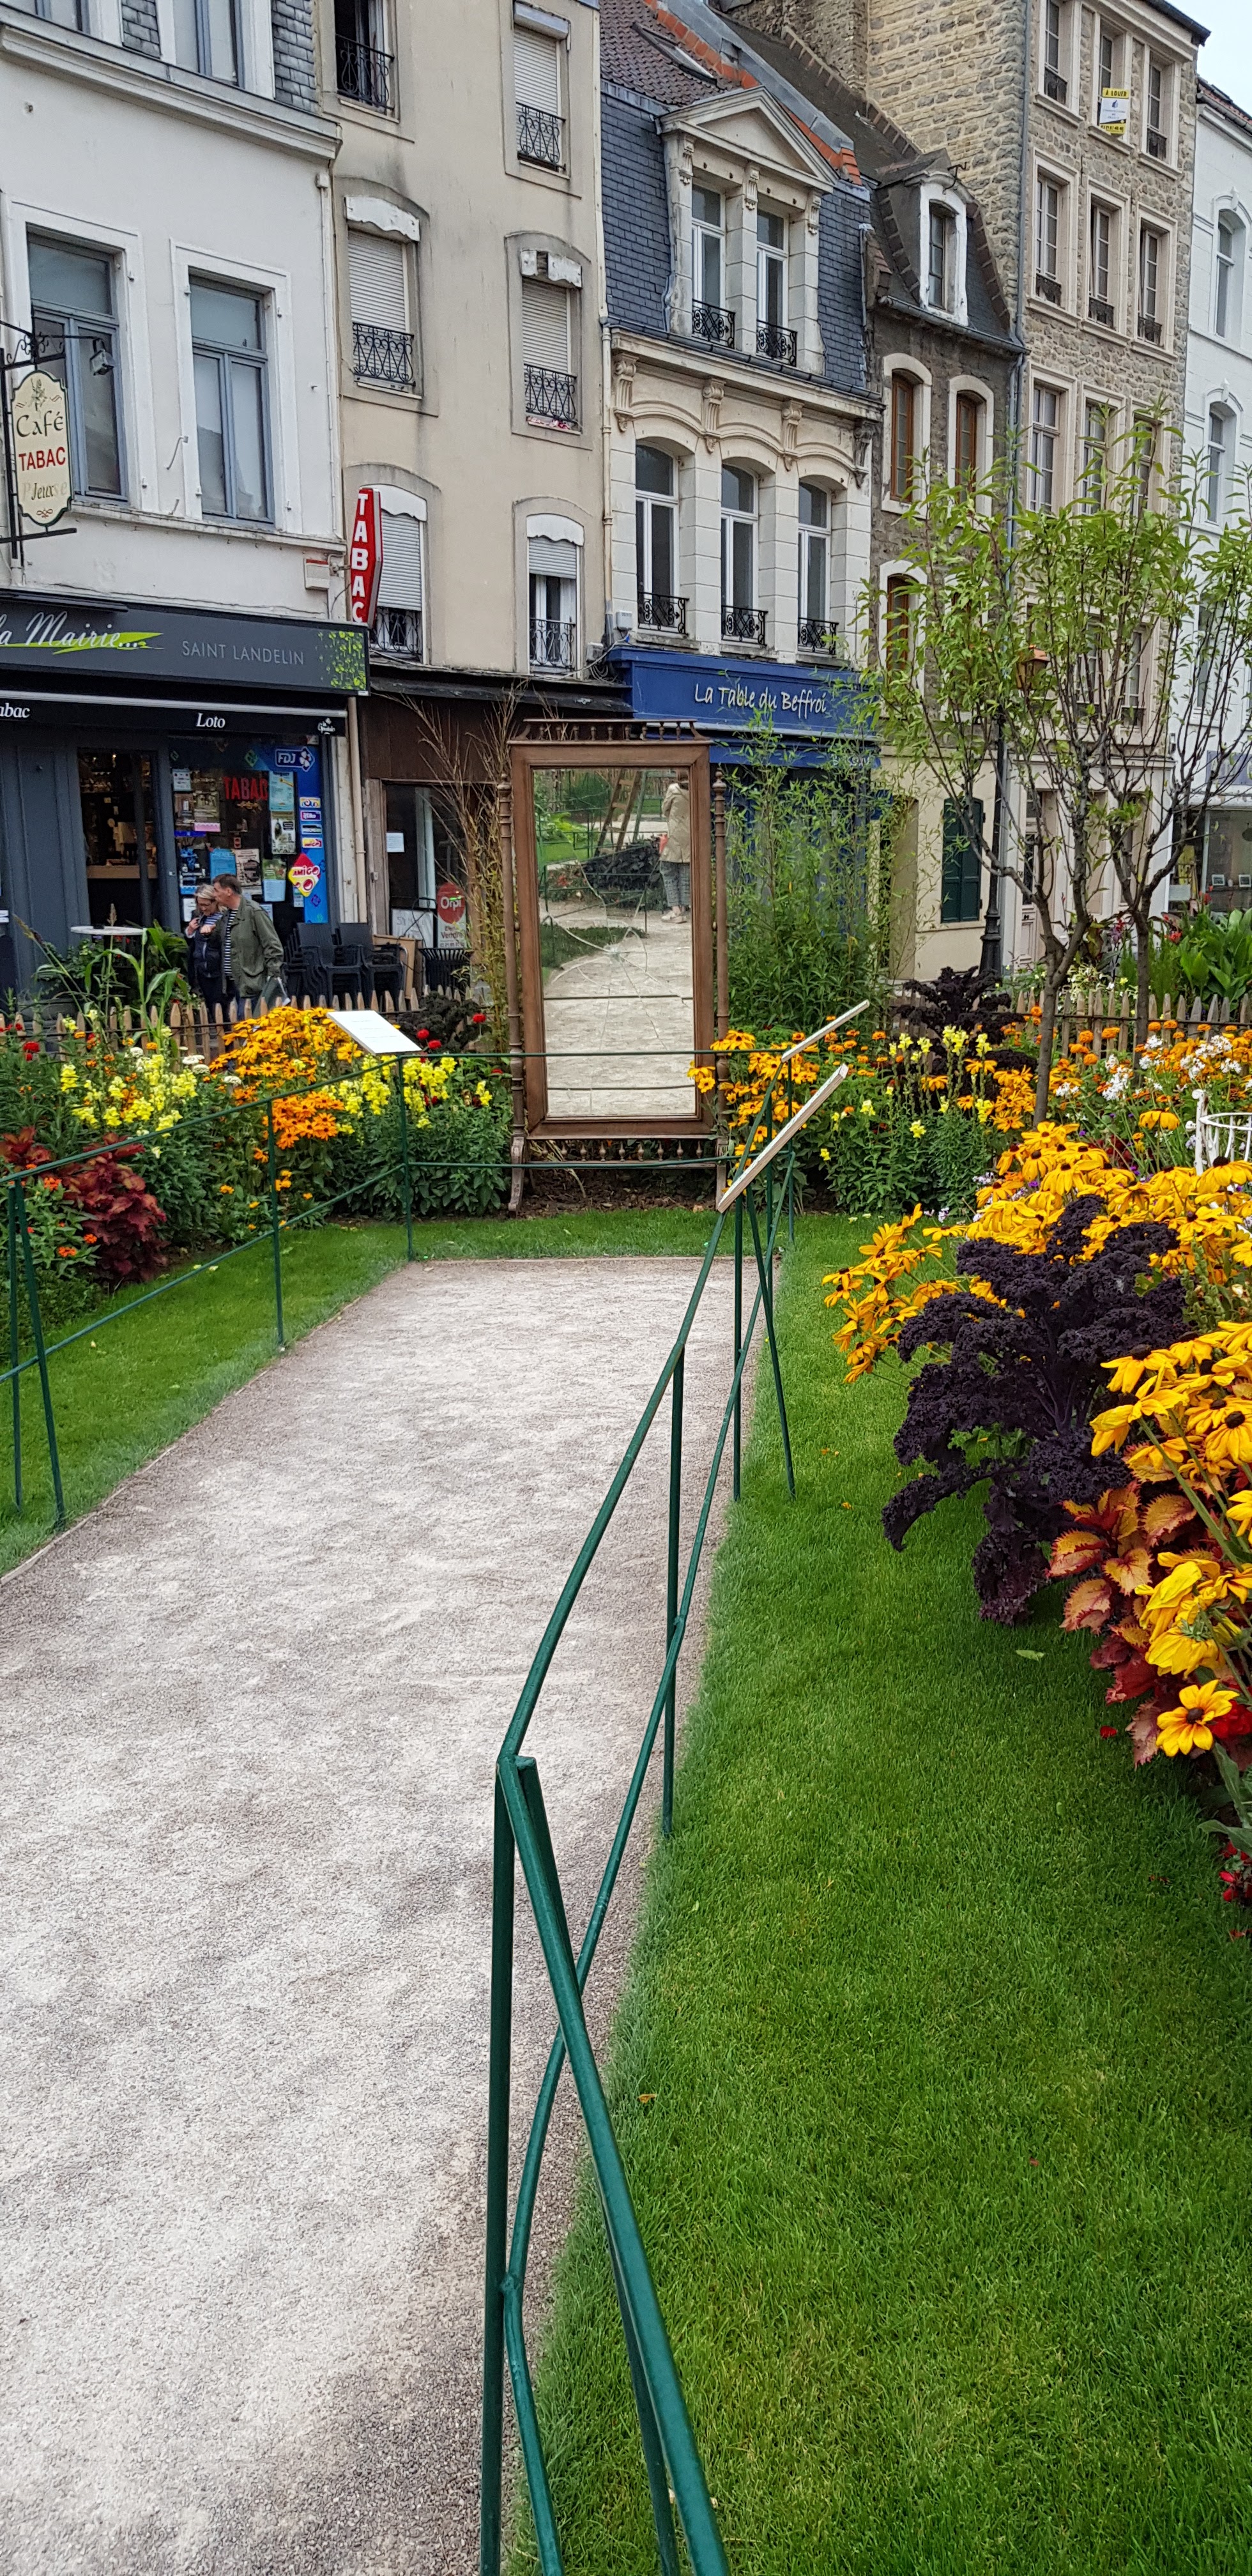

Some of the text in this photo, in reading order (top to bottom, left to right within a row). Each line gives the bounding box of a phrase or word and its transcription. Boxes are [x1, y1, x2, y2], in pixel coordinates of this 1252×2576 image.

[16, 410, 63, 437] Café
[19, 447, 66, 471] TABAC
[31, 482, 54, 500] Jeux
[352, 493, 369, 623] TABAC
[182, 640, 304, 665] SAINT LANDELIN
[695, 683, 827, 719] La Table du Beffroi
[196, 712, 225, 728] Loto
[277, 753, 296, 764] FDJ
[222, 776, 268, 801] TABAC
